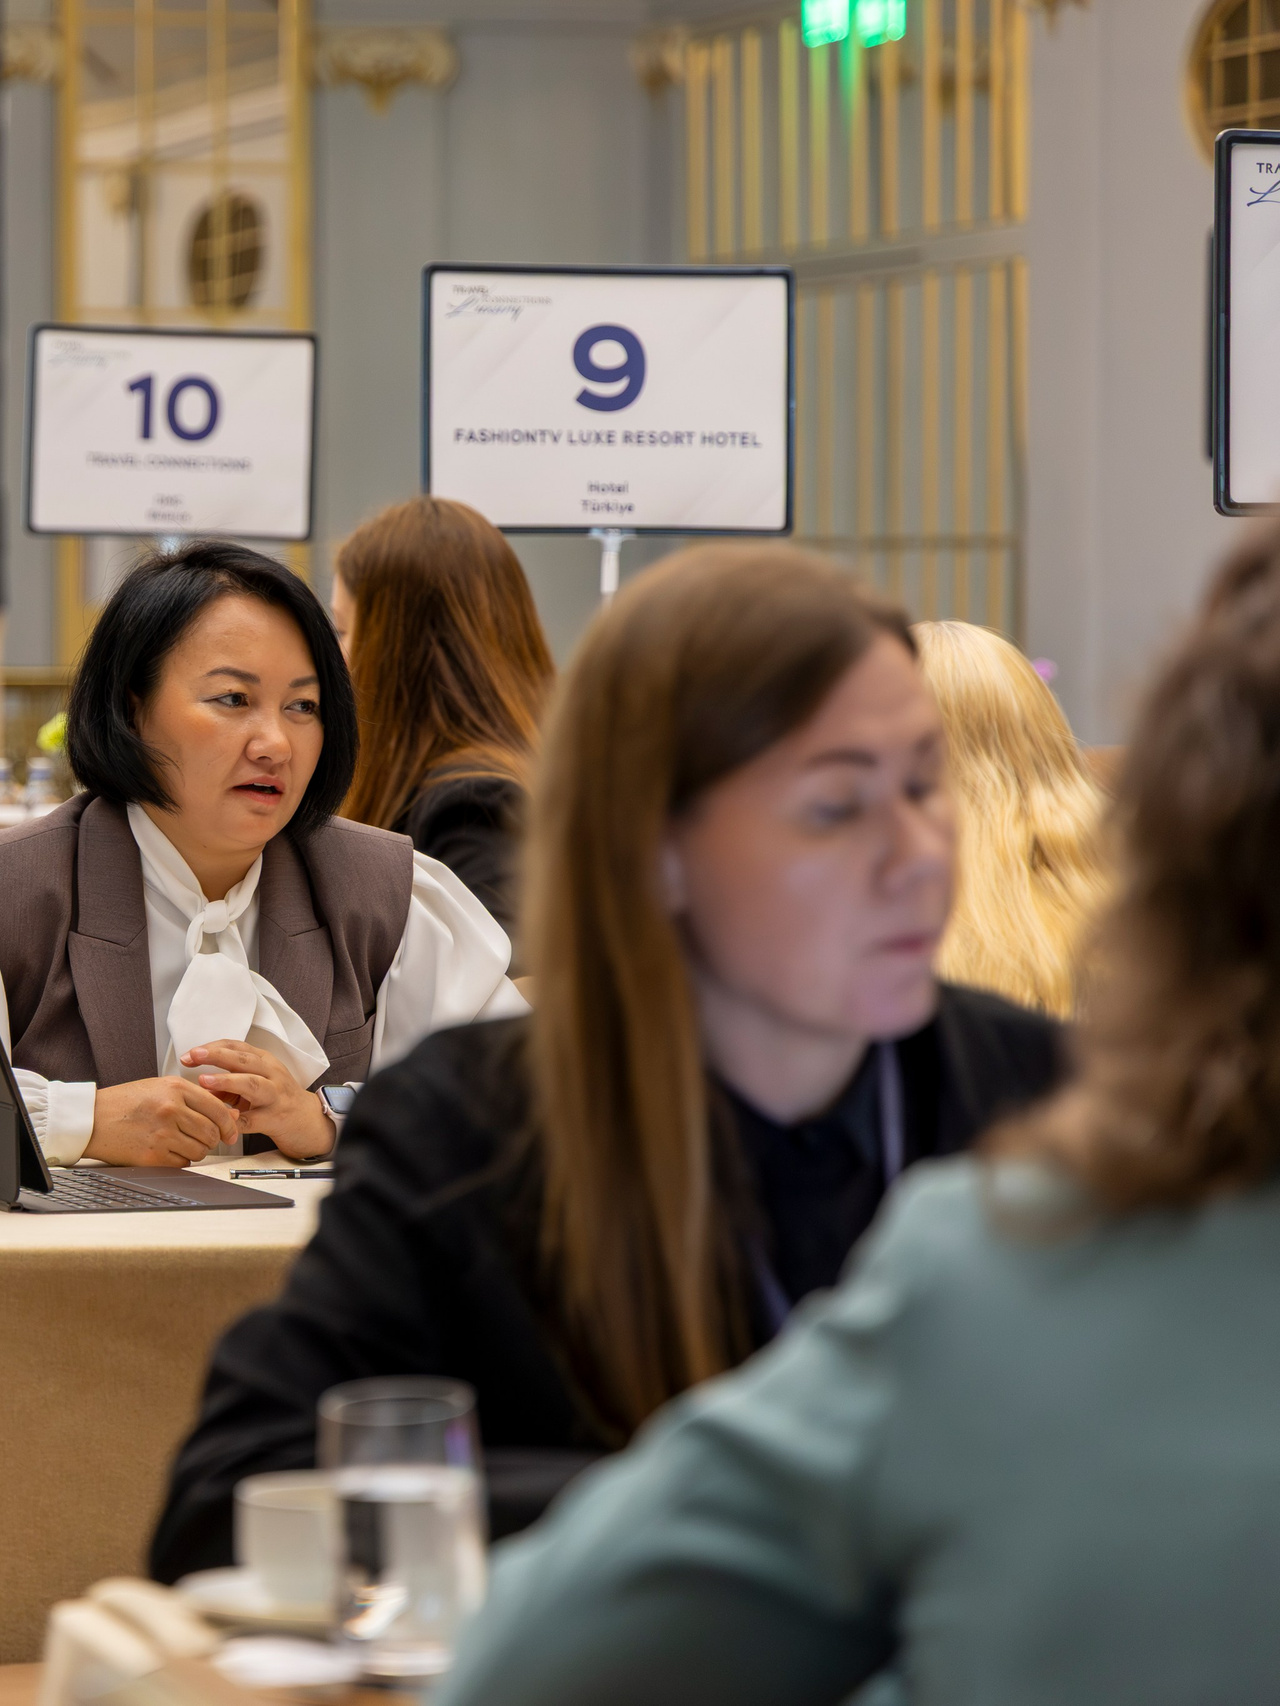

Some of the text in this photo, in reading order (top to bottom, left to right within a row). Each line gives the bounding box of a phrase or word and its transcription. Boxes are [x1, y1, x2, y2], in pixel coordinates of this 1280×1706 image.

[572, 324, 646, 412] 9
[127, 373, 221, 442] 10
[454, 428, 762, 448] FASHIONTV LUXE RESORT HOTEL
[587, 481, 629, 494] Hotel
[580, 499, 635, 516] Türkiye
